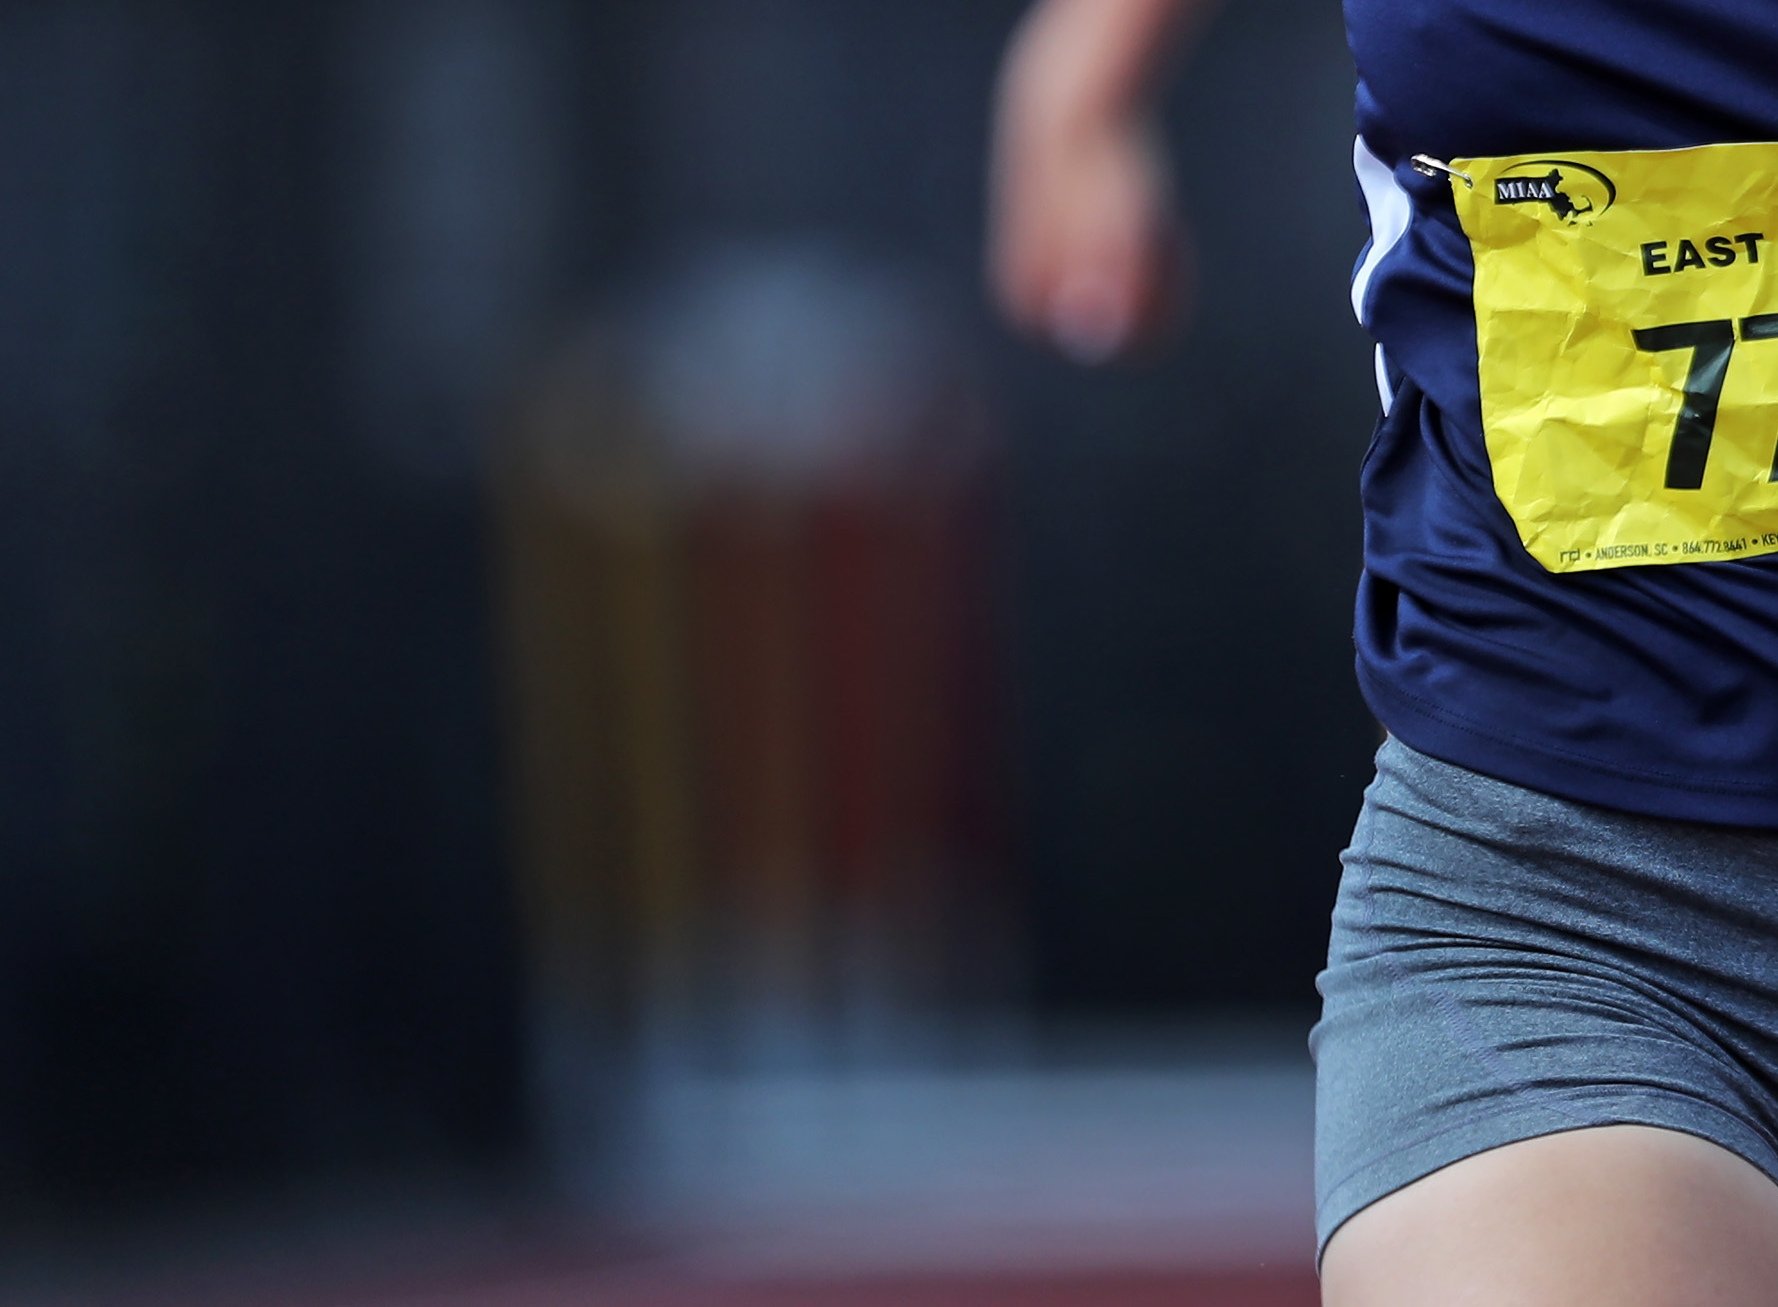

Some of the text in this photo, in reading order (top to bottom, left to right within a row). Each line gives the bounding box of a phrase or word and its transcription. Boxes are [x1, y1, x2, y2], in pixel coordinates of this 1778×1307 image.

[1497, 180, 1555, 200] MIAA
[1640, 233, 1764, 277] EAST
[1654, 543, 1668, 557] SC
